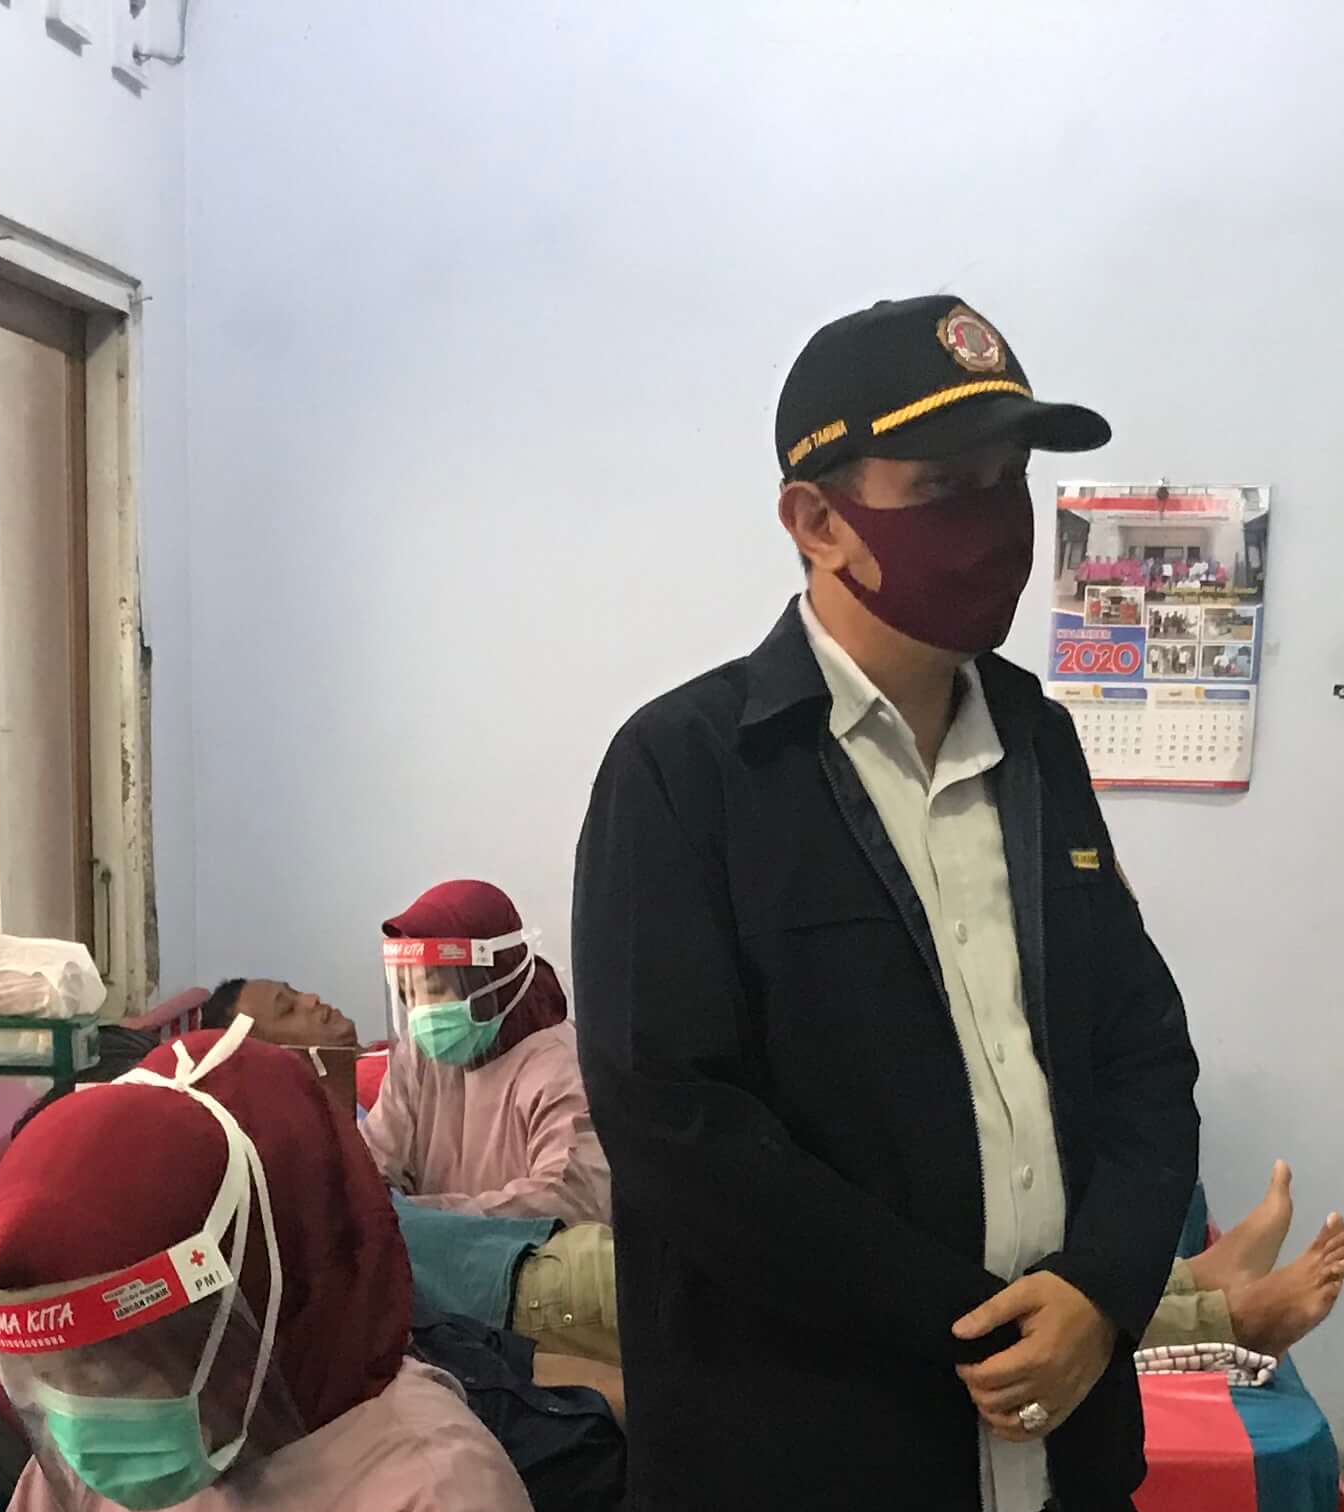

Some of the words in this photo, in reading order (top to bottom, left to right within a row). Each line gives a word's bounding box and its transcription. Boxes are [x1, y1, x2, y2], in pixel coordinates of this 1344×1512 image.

[1056, 641, 1141, 675] 2020
[194, 1269, 223, 1292] PMI
[26, 1301, 75, 1334] KITA
